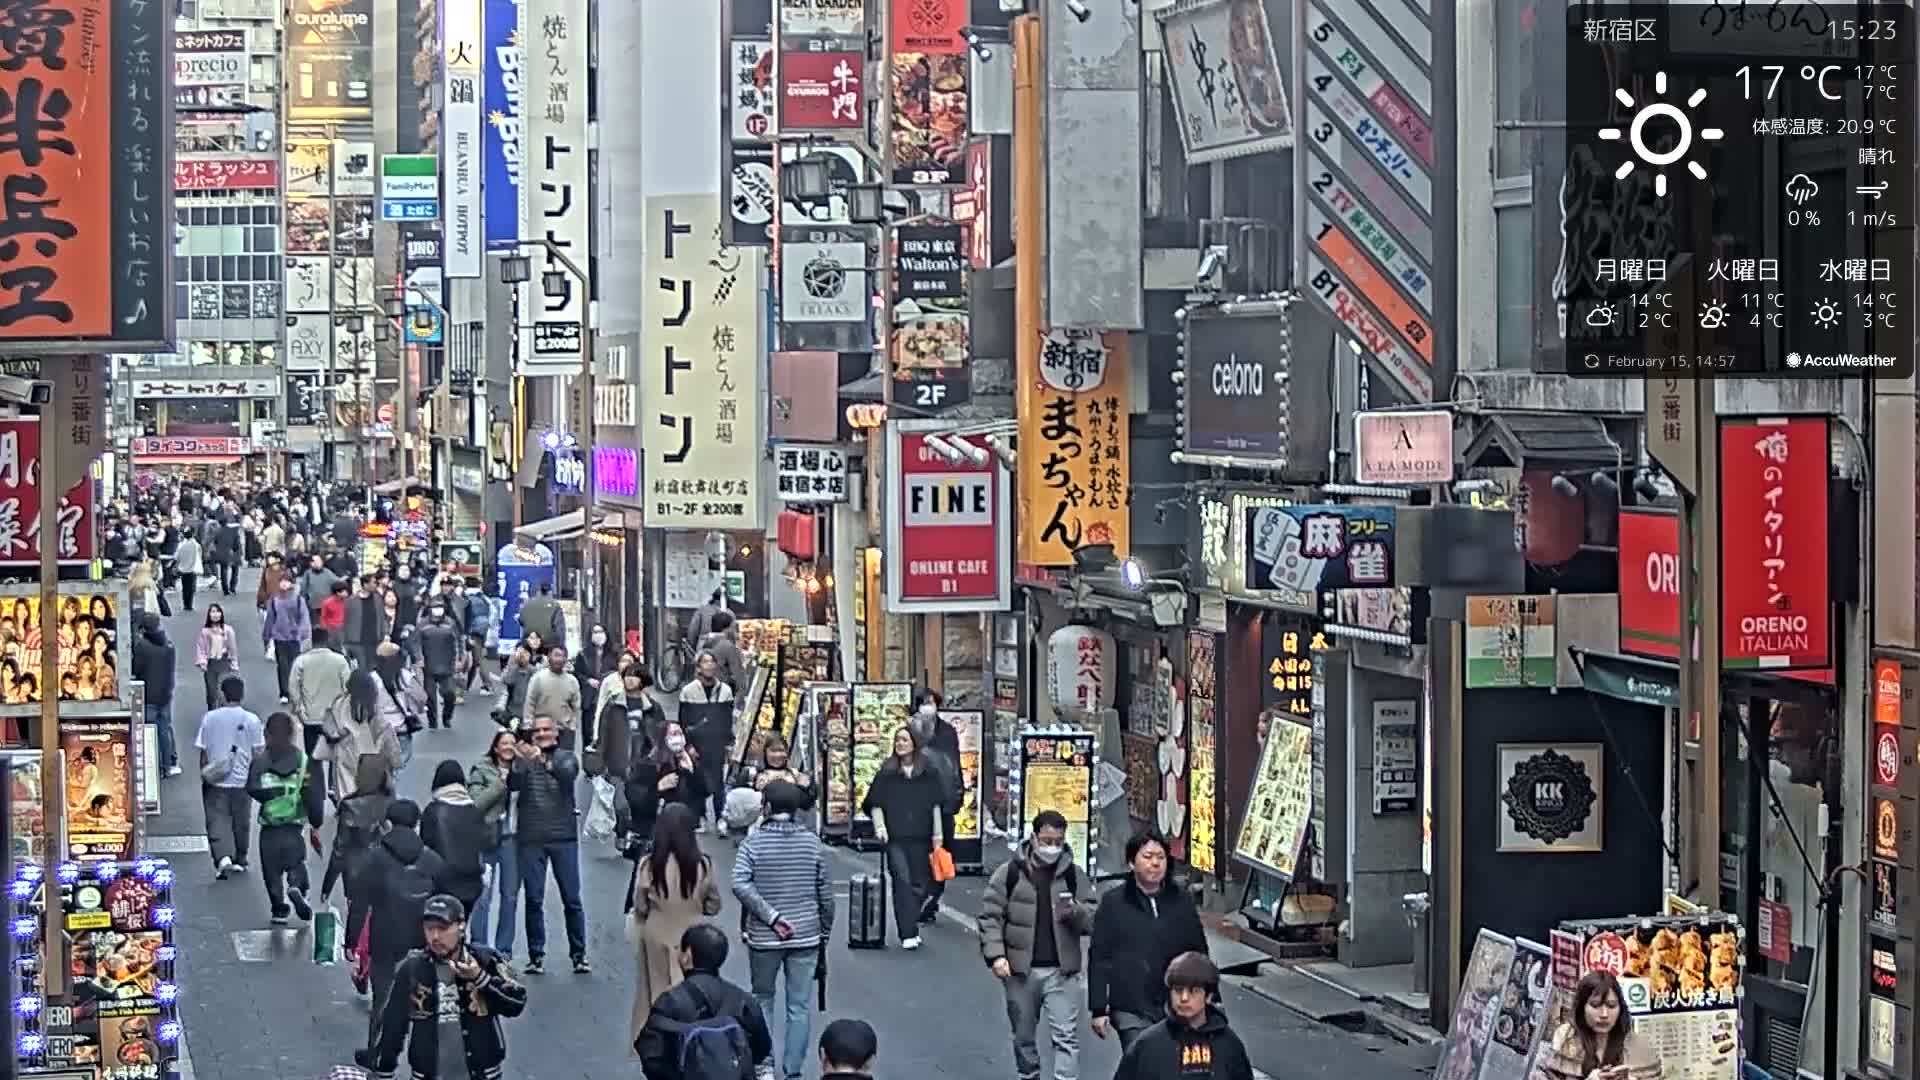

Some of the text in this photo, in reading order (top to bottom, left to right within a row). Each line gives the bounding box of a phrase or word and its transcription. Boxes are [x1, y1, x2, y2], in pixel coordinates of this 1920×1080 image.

[1313, 22, 1335, 42] 5
[449, 40, 474, 104] 火鍋
[542, 14, 569, 125] 焼とん酒場
[830, 58, 859, 121] 牛門
[1313, 75, 1333, 92] 4
[1314, 123, 1333, 143] 3
[385, 181, 435, 193] FamilyMart
[1312, 173, 1334, 193] 2
[1315, 222, 1333, 241] 1
[901, 256, 959, 271] Walton's
[1311, 268, 1340, 299] B1
[660, 209, 692, 464] トントン
[712, 324, 737, 444] 焼とん酒場
[1212, 352, 1263, 396] celona
[916, 385, 947, 405] 2F
[779, 449, 844, 473] 酒場心
[1040, 396, 1085, 550] まっちゃん
[653, 479, 750, 497] 新宿歌舞伎町店
[779, 475, 844, 496] 新宿本店
[911, 485, 986, 514] FINE
[1349, 520, 1389, 535] フリー
[1754, 430, 1789, 605] 俺のイタリアン
[1304, 513, 1387, 582] 麻雀
[910, 560, 989, 575] ONLINE CAFE
[1740, 616, 1808, 634] ORENO
[1739, 634, 1809, 652] ITALIAN
[1535, 782, 1564, 800] KK
[1654, 988, 1735, 1009] 炭火焼き鳥
